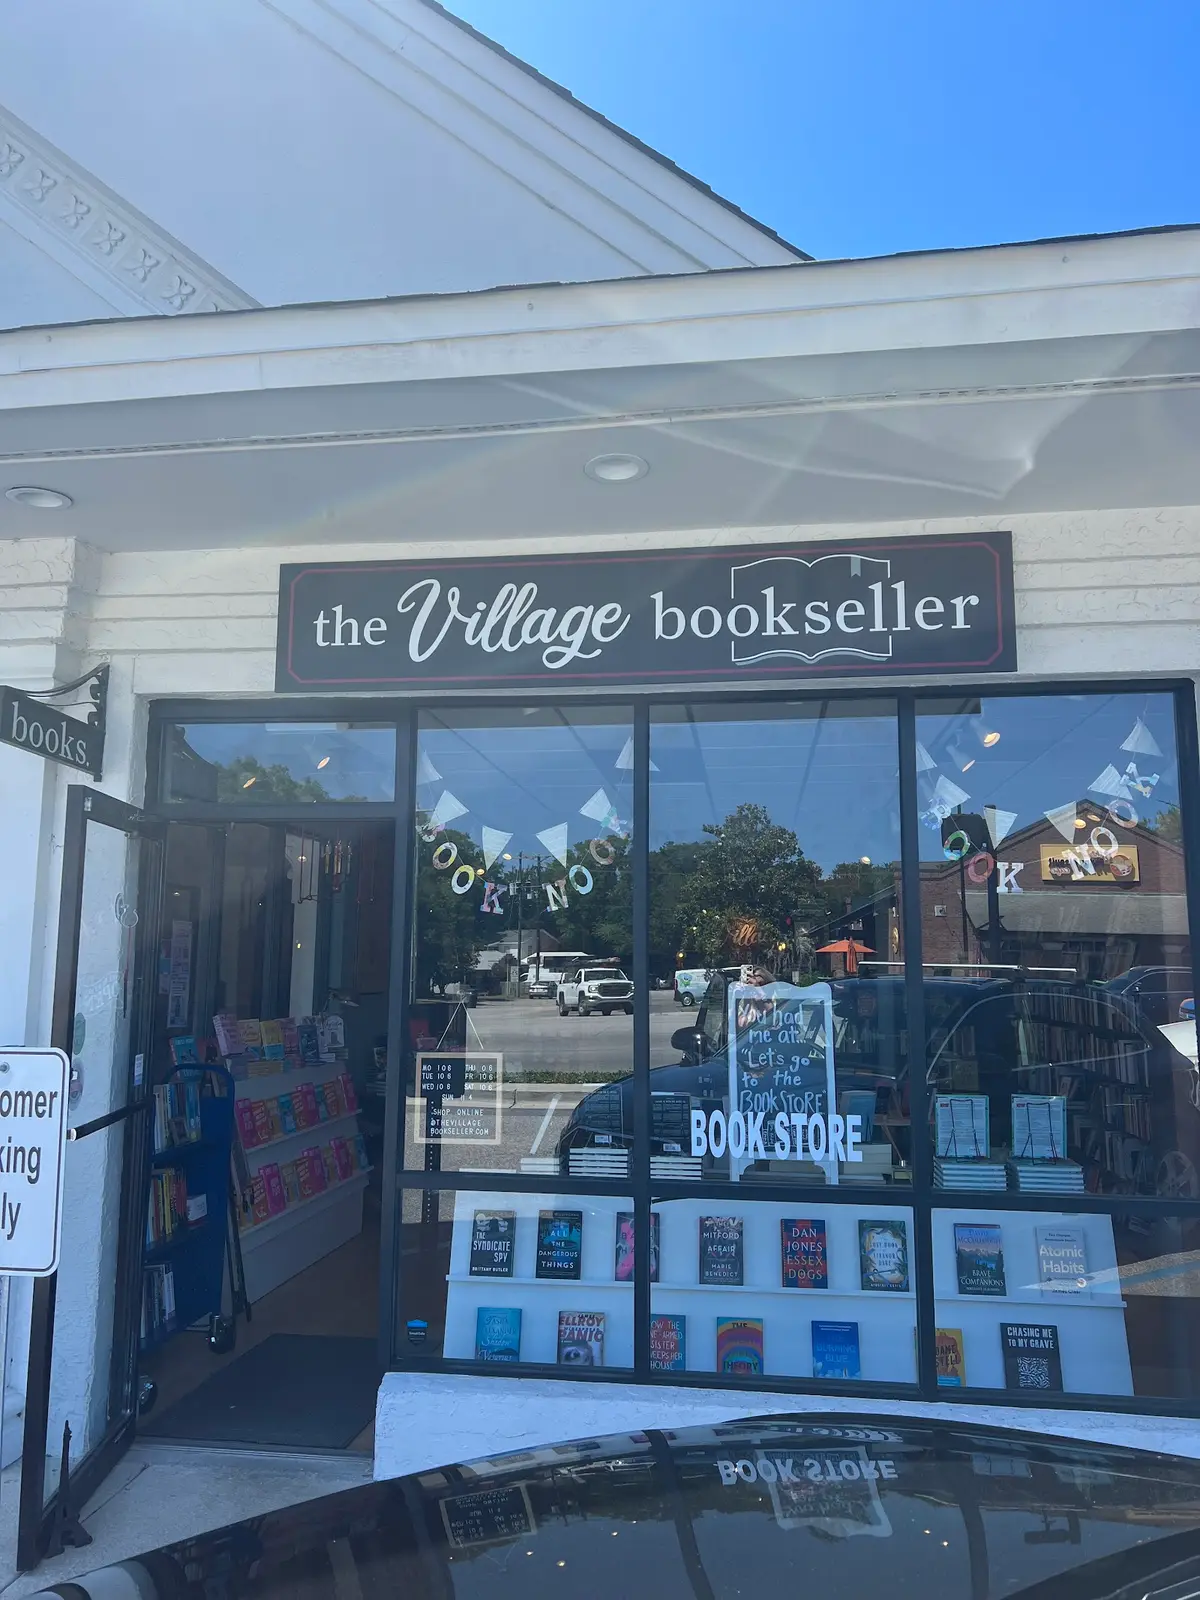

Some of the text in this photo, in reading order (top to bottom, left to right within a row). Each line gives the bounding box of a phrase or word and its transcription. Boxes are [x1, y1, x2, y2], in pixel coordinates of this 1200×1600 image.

[314, 578, 981, 669] the Village bookseller
[749, 1029, 772, 1043] me
[791, 1057, 810, 1073] go
[742, 1070, 802, 1088] to the
[433, 1109, 484, 1117] SHOP ONLINE
[691, 1109, 767, 1160] BOOK
[774, 1111, 863, 1162] STORE
[0, 1136, 42, 1185] ing
[703, 1232, 740, 1240] MITFORD
[792, 1227, 817, 1238] DAN
[473, 1240, 511, 1252] SYNDICATE
[707, 1244, 736, 1252] AFFAIR
[786, 1240, 823, 1254] JONES
[1039, 1245, 1085, 1258] Atomic
[493, 1252, 508, 1263] SPY
[538, 1250, 578, 1258] DANGEROUS
[786, 1254, 823, 1266] ESSEX
[541, 1260, 574, 1269] THINGS
[1043, 1260, 1085, 1274] Habits
[788, 1268, 822, 1280] DOGS
[972, 1269, 991, 1277] BRAVE
[959, 1277, 1004, 1287] COMPANIONS
[560, 1315, 604, 1327] ELLROY
[651, 1320, 680, 1330] OW THE
[560, 1329, 604, 1342] PANIC
[1007, 1326, 1053, 1339] CHASING ME
[650, 1340, 675, 1350] SISTER
[1008, 1338, 1054, 1349] TO MY GRAVE
[670, 1352, 683, 1361] HER
[650, 1361, 675, 1371] HOUSE
